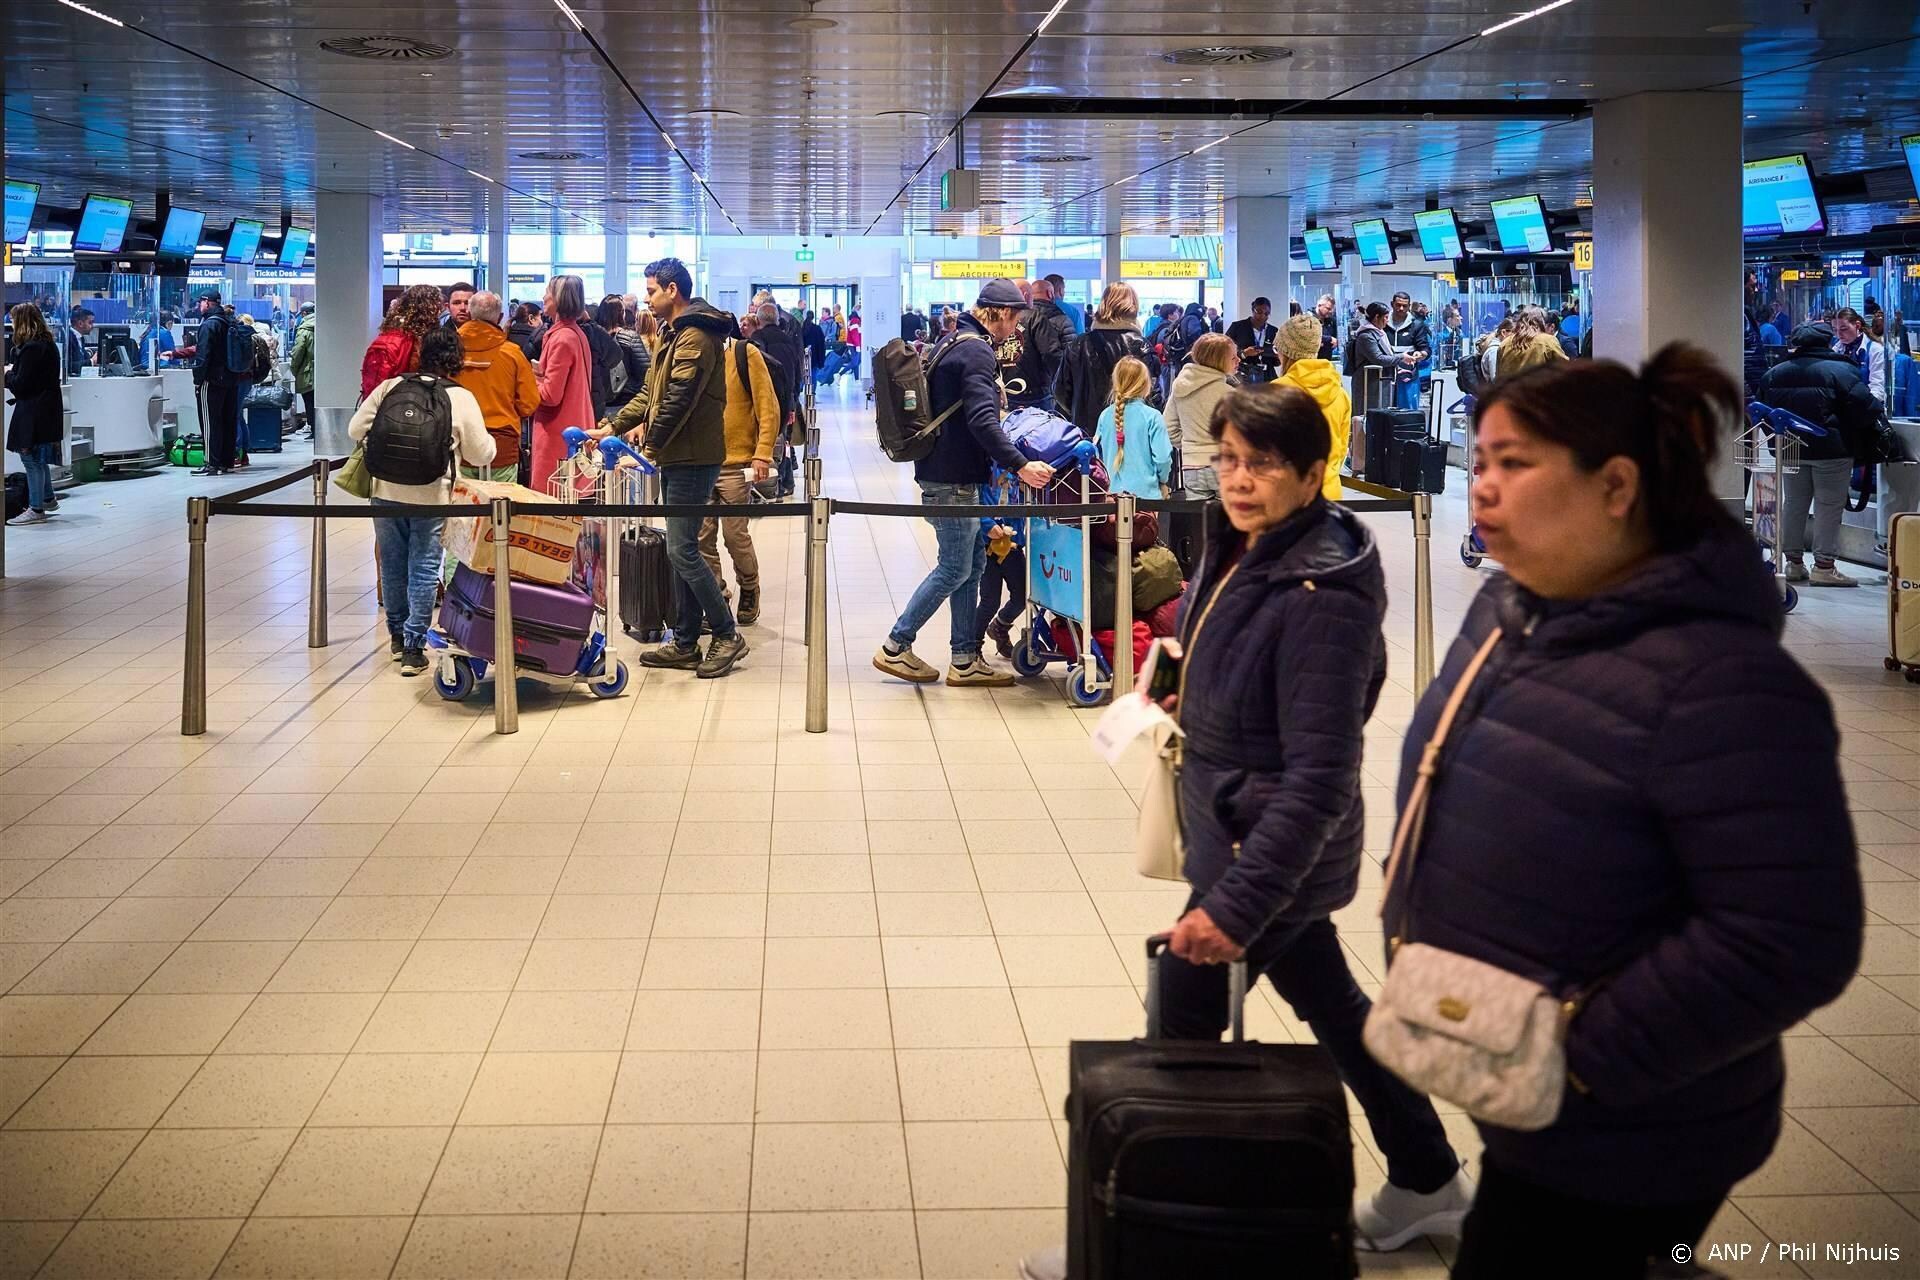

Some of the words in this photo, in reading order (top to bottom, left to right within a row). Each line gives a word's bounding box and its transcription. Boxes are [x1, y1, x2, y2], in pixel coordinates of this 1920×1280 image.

[1796, 157, 1802, 166] 6
[1748, 175, 1779, 185] AIRFRANCE
[34, 185, 39, 193] 5
[1578, 244, 1591, 262] 16
[204, 269, 223, 277] Desk
[255, 269, 279, 277] Ticket
[280, 269, 298, 277] Desk
[802, 273, 808, 283] E
[532, 540, 572, 559] SEAL
[1057, 566, 1072, 584] TUI
